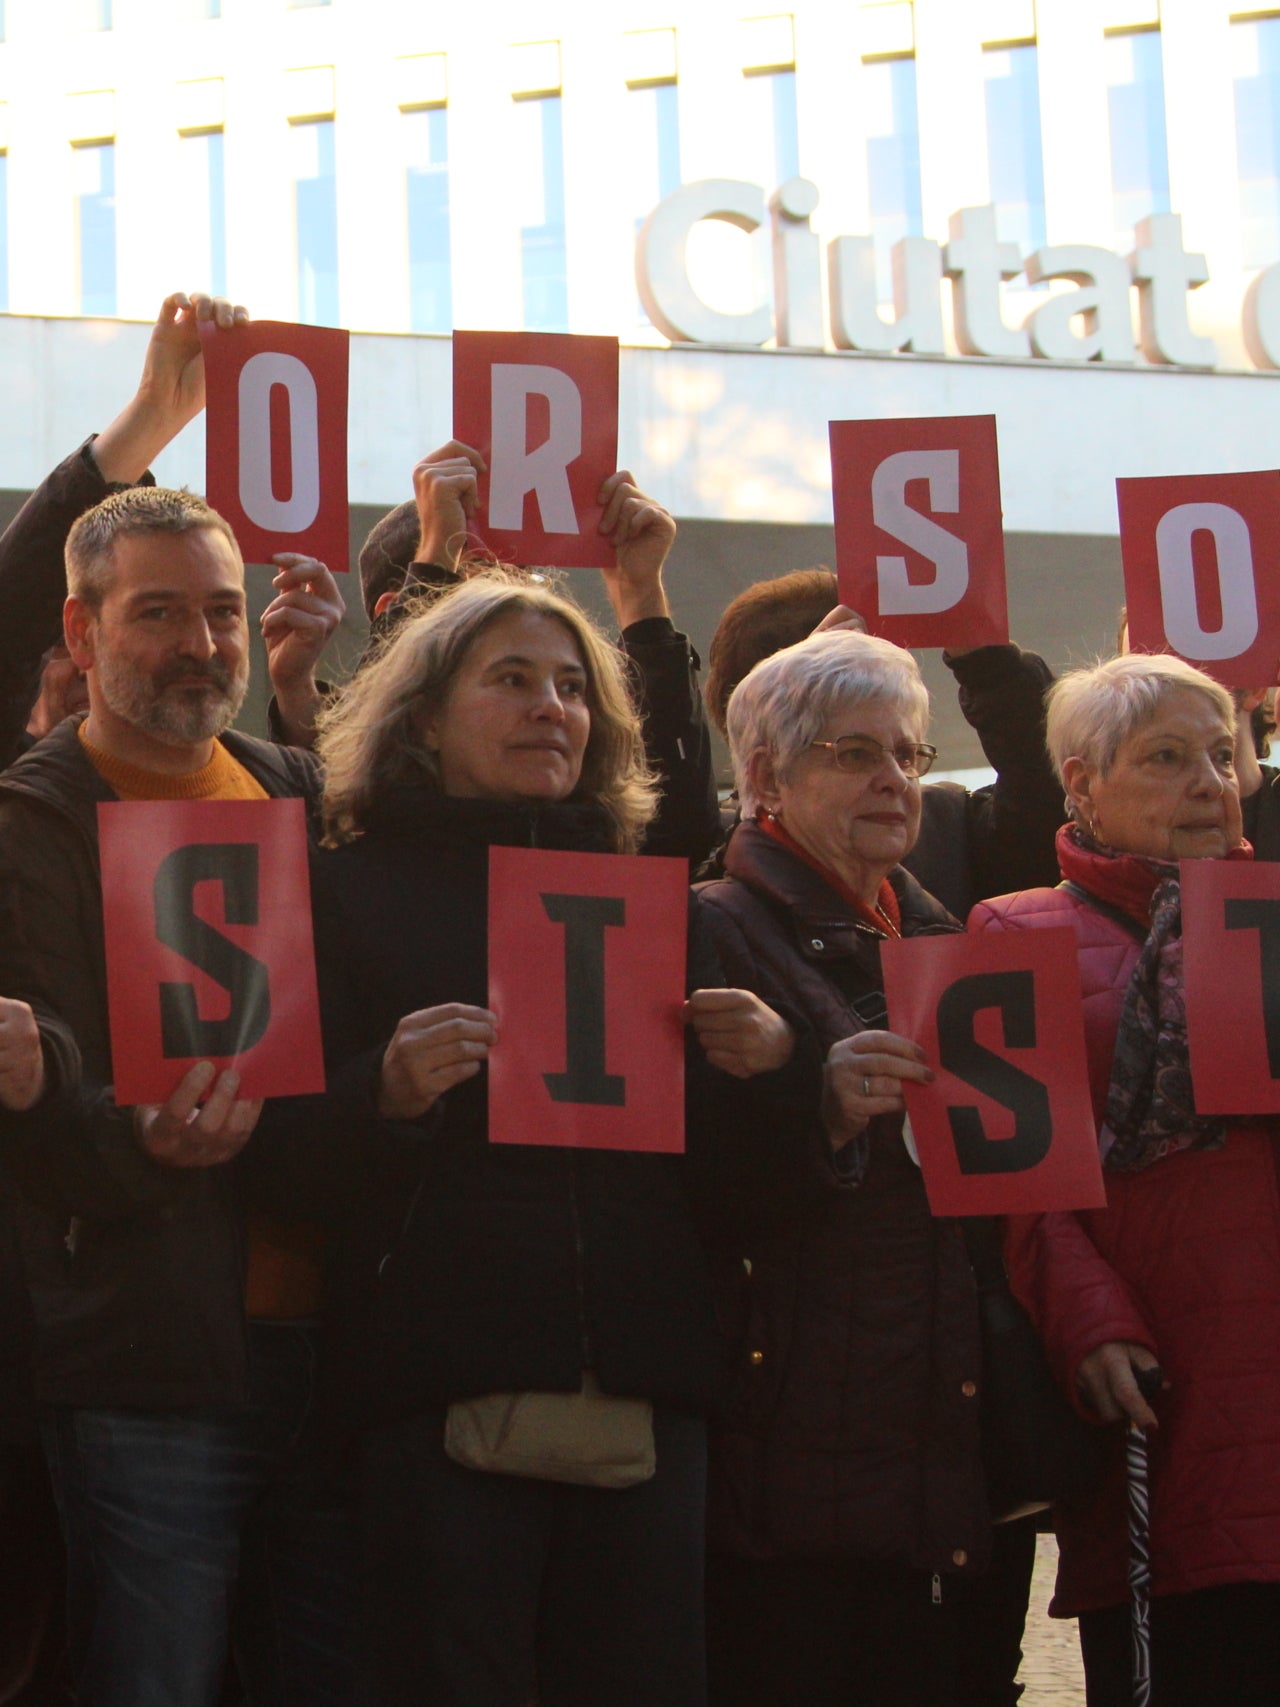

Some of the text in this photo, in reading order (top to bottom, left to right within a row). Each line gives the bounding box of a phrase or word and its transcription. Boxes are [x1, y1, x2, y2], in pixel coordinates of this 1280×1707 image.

[634, 177, 1216, 366] Ciutat
[238, 352, 318, 533] O
[489, 363, 582, 535] R
[871, 449, 969, 616] S
[1155, 502, 1259, 660] O
[153, 842, 271, 1059] S
[539, 892, 626, 1107] I
[936, 970, 1053, 1175] S
